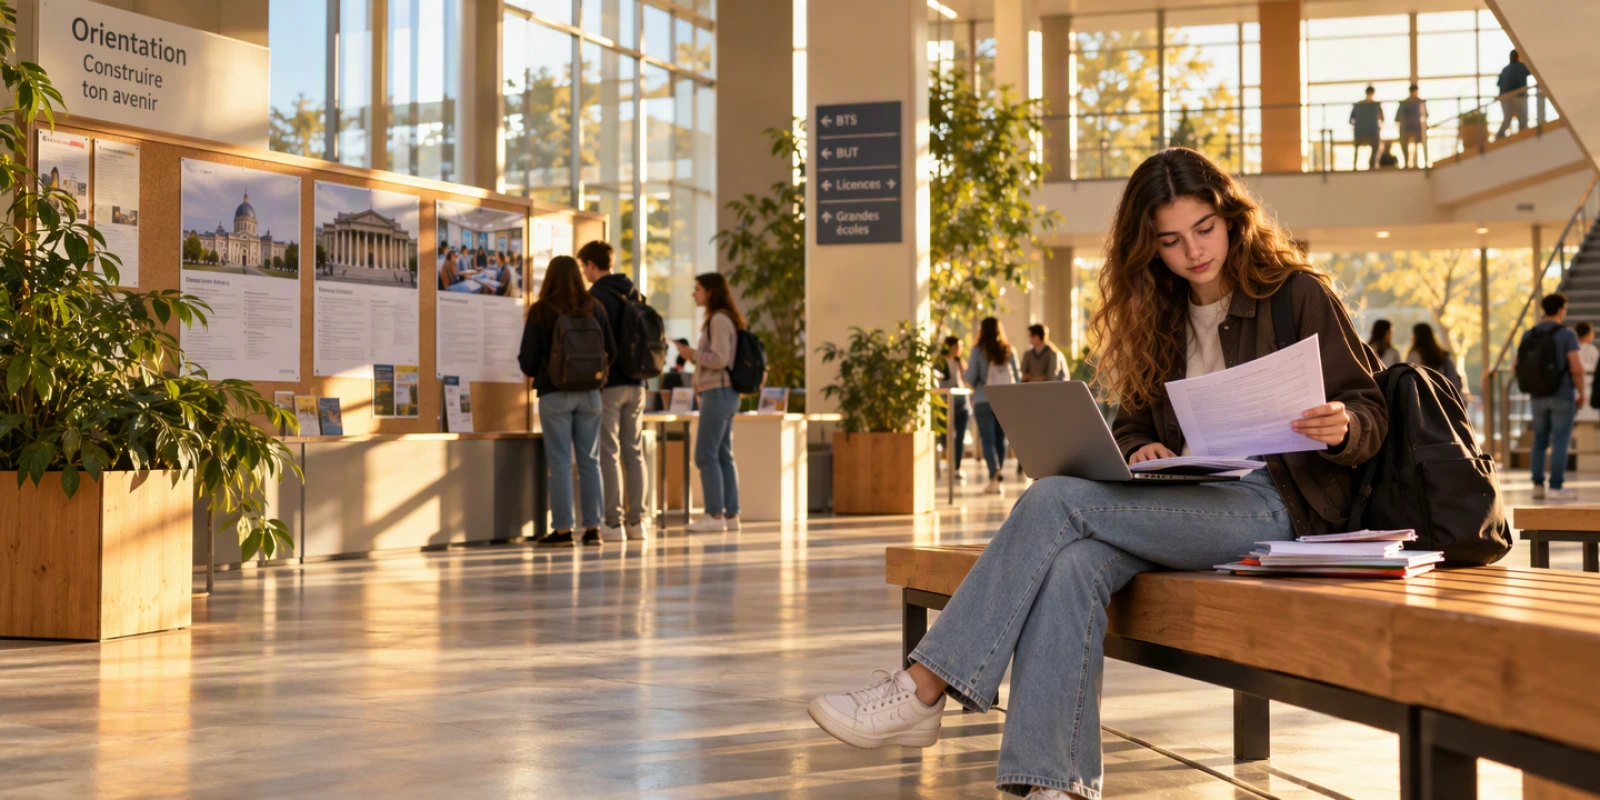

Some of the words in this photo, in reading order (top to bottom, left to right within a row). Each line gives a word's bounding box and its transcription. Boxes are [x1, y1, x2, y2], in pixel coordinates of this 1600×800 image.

[72, 17, 187, 66] Orientation
[83, 54, 163, 88] Construire
[83, 80, 108, 101] ton
[112, 89, 158, 111] avenir
[836, 114, 858, 126] BTS
[836, 147, 859, 158] BUT
[836, 179, 881, 190] Licences
[836, 210, 880, 222] Grandes
[836, 224, 869, 235] écoles
